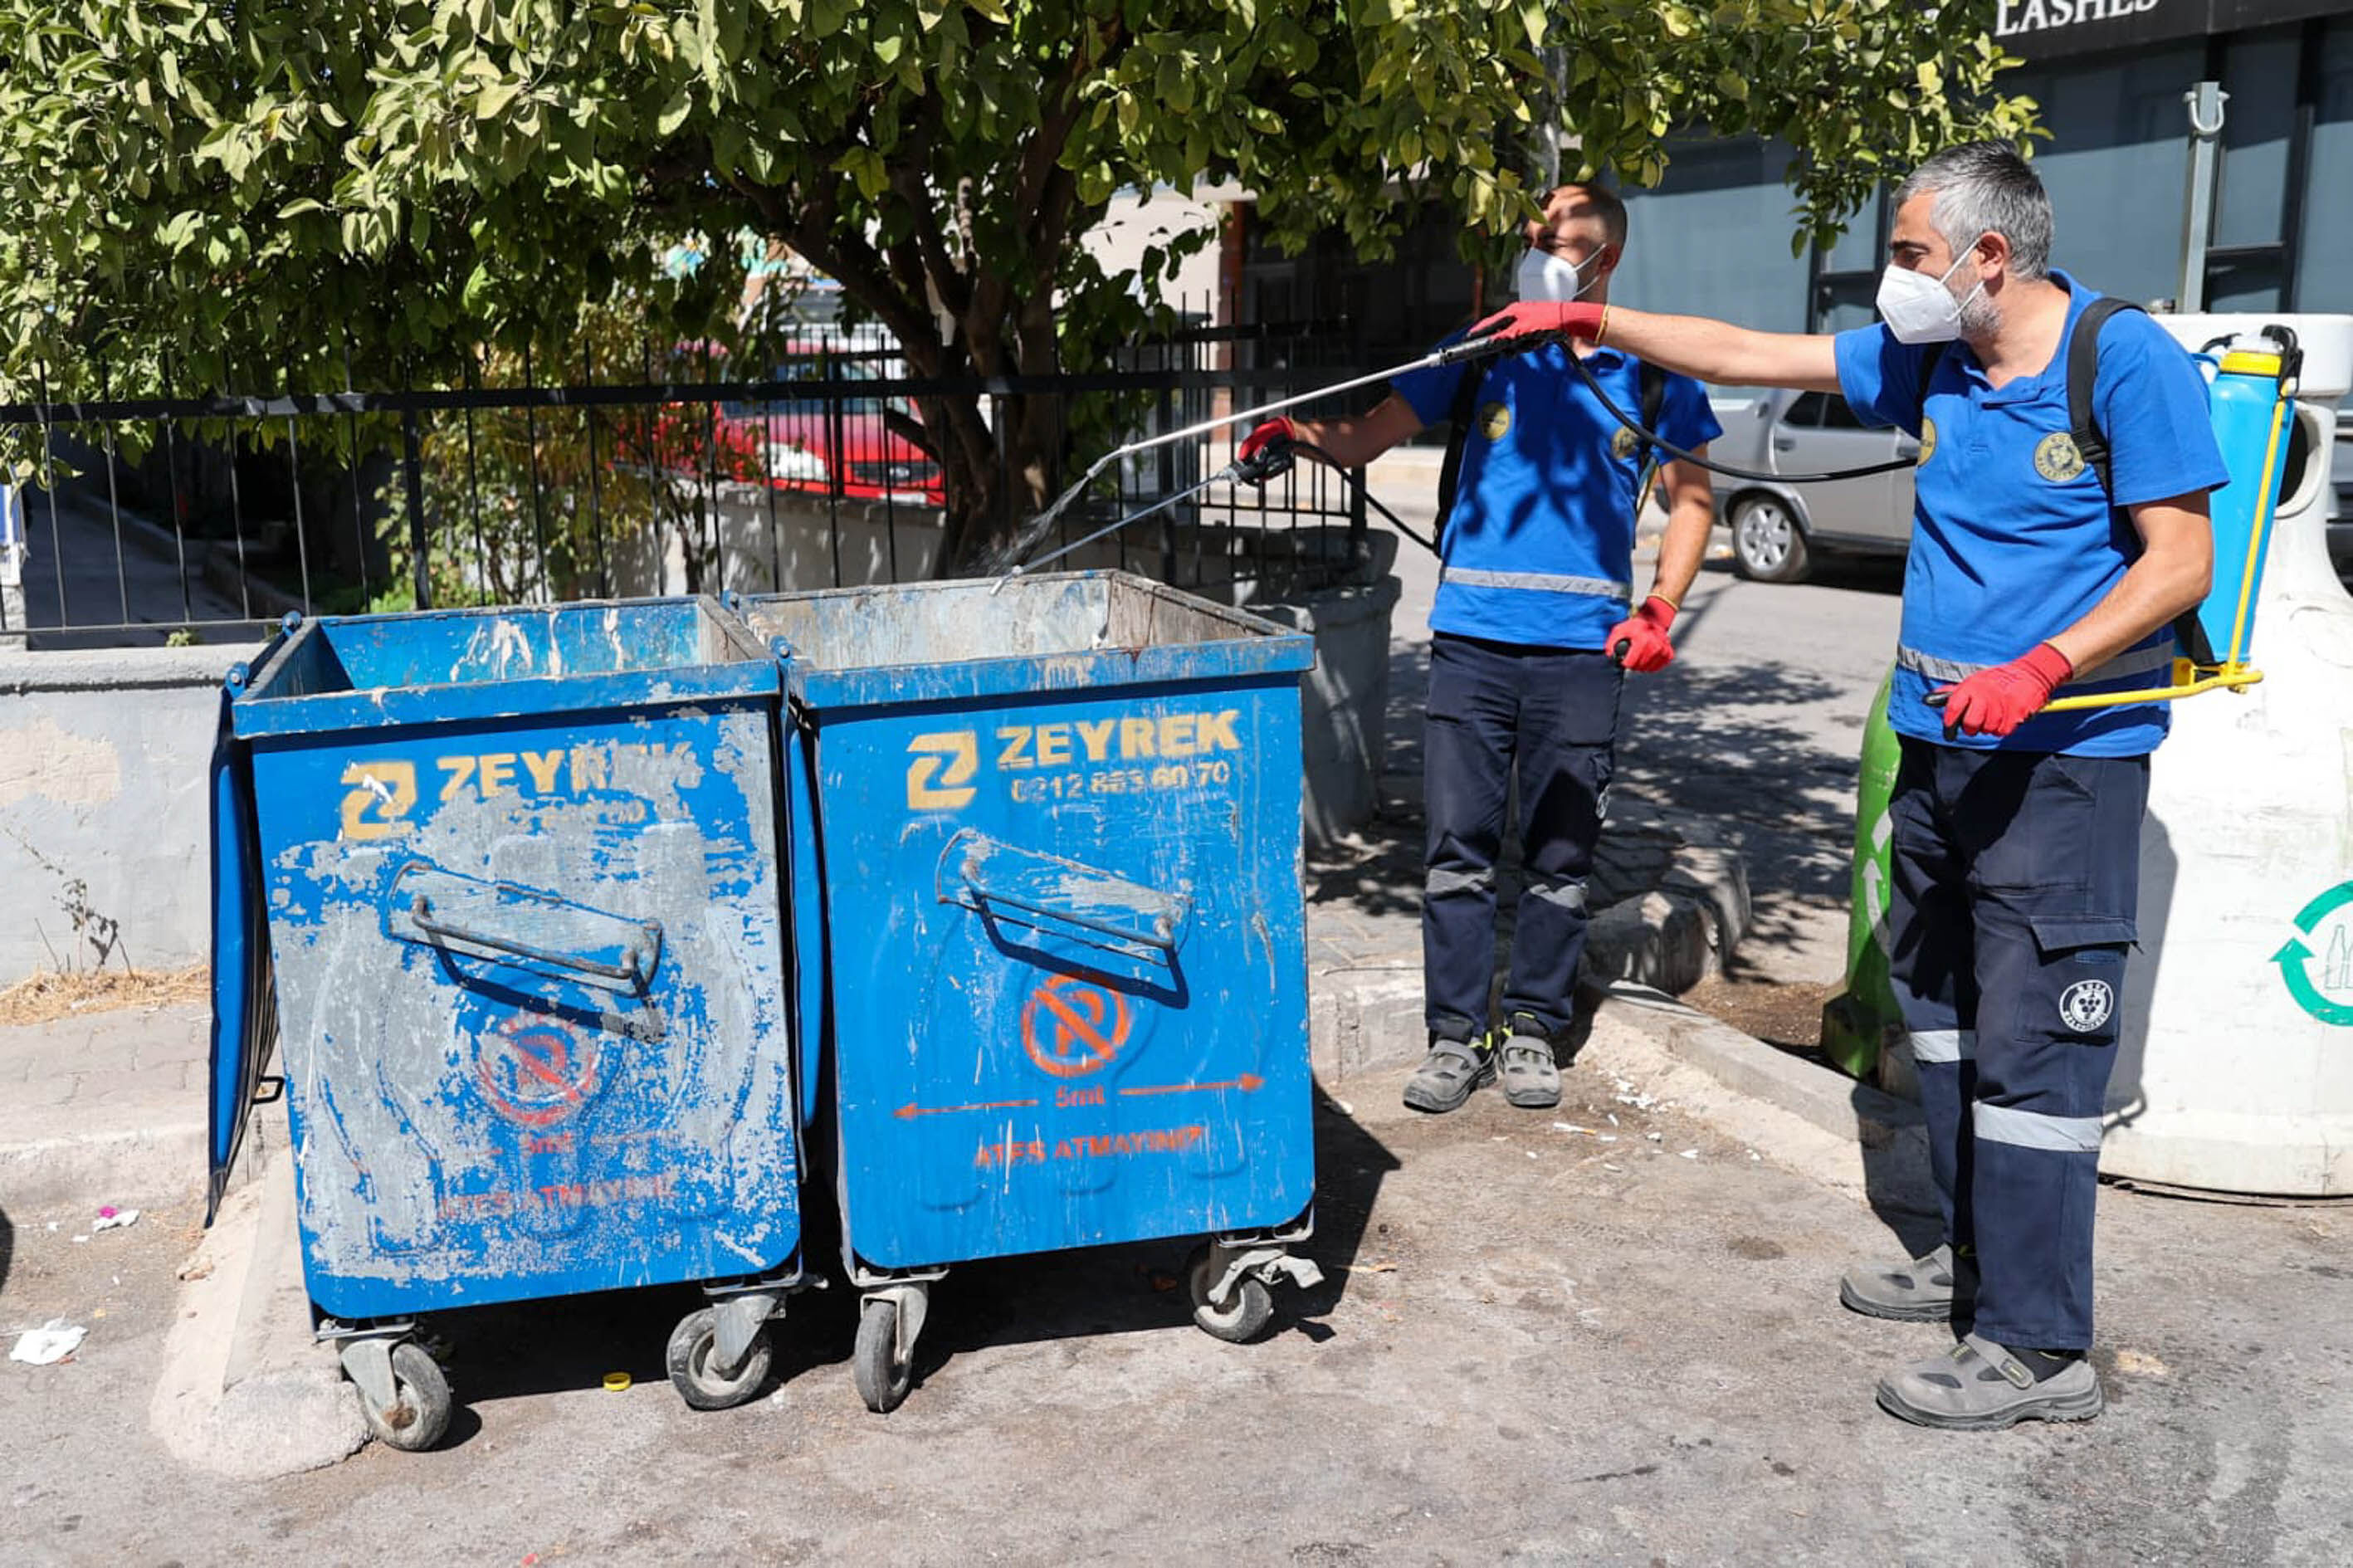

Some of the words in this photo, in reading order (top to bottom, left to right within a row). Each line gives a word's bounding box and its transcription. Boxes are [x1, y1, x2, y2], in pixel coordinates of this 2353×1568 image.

[997, 710, 1242, 770] ZEYREK
[437, 740, 702, 802] ZEYR
[1196, 760, 1230, 787] 70
